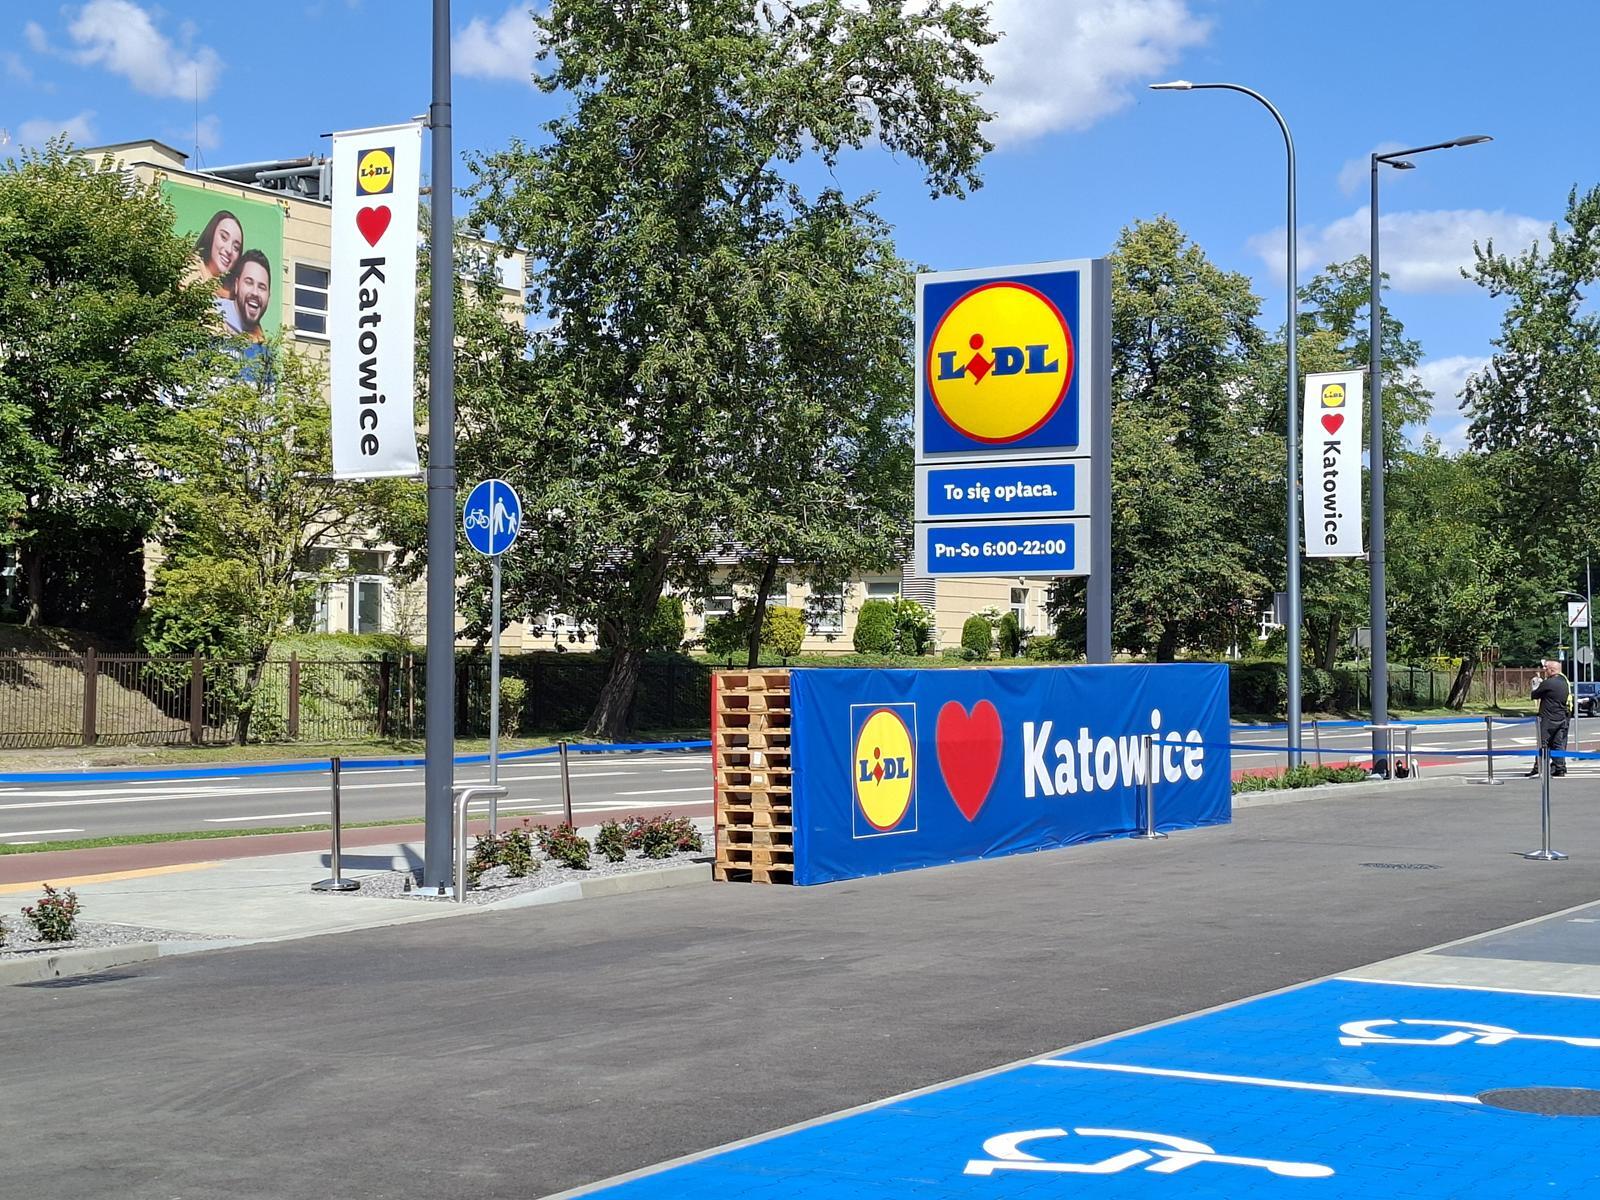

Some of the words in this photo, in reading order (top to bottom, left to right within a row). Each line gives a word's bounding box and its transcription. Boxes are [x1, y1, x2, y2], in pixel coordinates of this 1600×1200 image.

[358, 257, 386, 457] Katowice
[943, 483, 964, 501] To
[967, 481, 991, 503] się
[994, 480, 1058, 502] opłaca.
[1323, 440, 1342, 546] Katowice
[934, 542, 980, 558] Pn-So
[982, 539, 1067, 557] 6:00-22:00
[1022, 708, 1205, 799] Katowice
